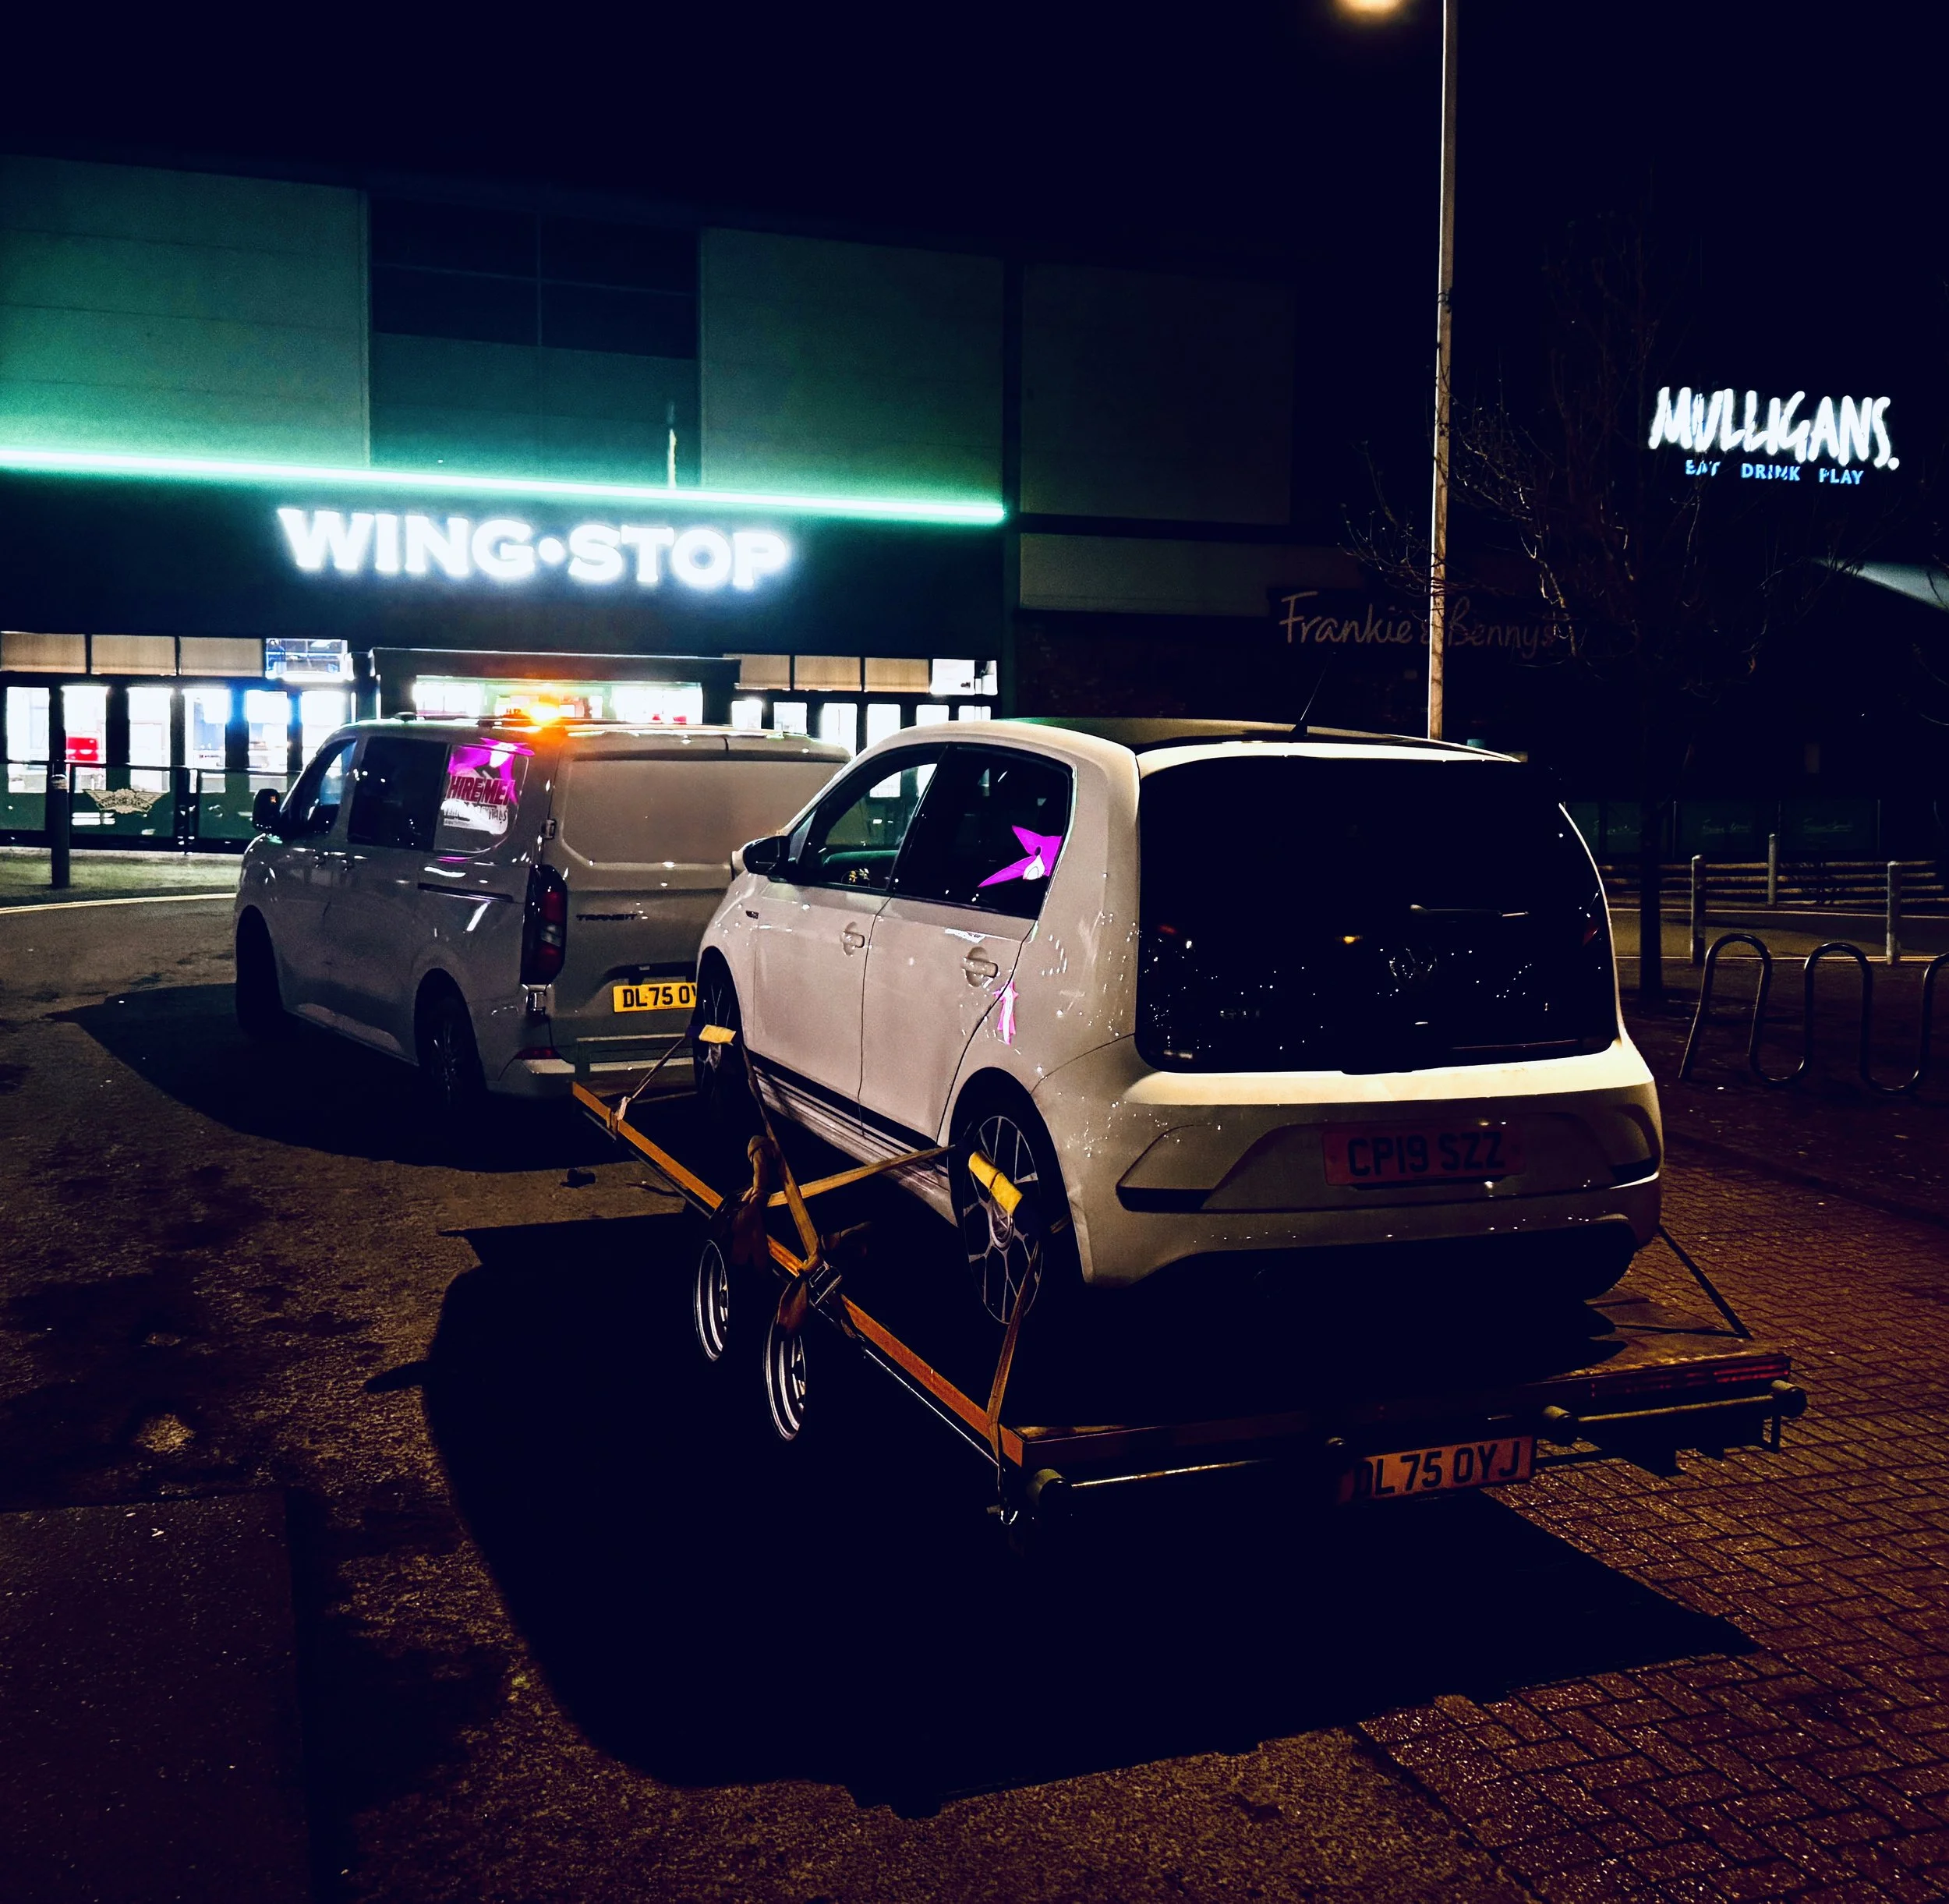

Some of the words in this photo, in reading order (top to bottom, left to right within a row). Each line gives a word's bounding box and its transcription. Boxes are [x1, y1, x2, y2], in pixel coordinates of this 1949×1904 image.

[1685, 458, 1721, 476] EAT
[1740, 462, 1801, 481] DRINK
[1818, 467, 1864, 486] PLAY
[1279, 590, 1413, 644] Frankie
[576, 913, 637, 922] TRANSIT
[1349, 1135, 1428, 1177] CP19
[1439, 1131, 1505, 1170] SZZ
[1453, 1441, 1521, 1484] OYJ
